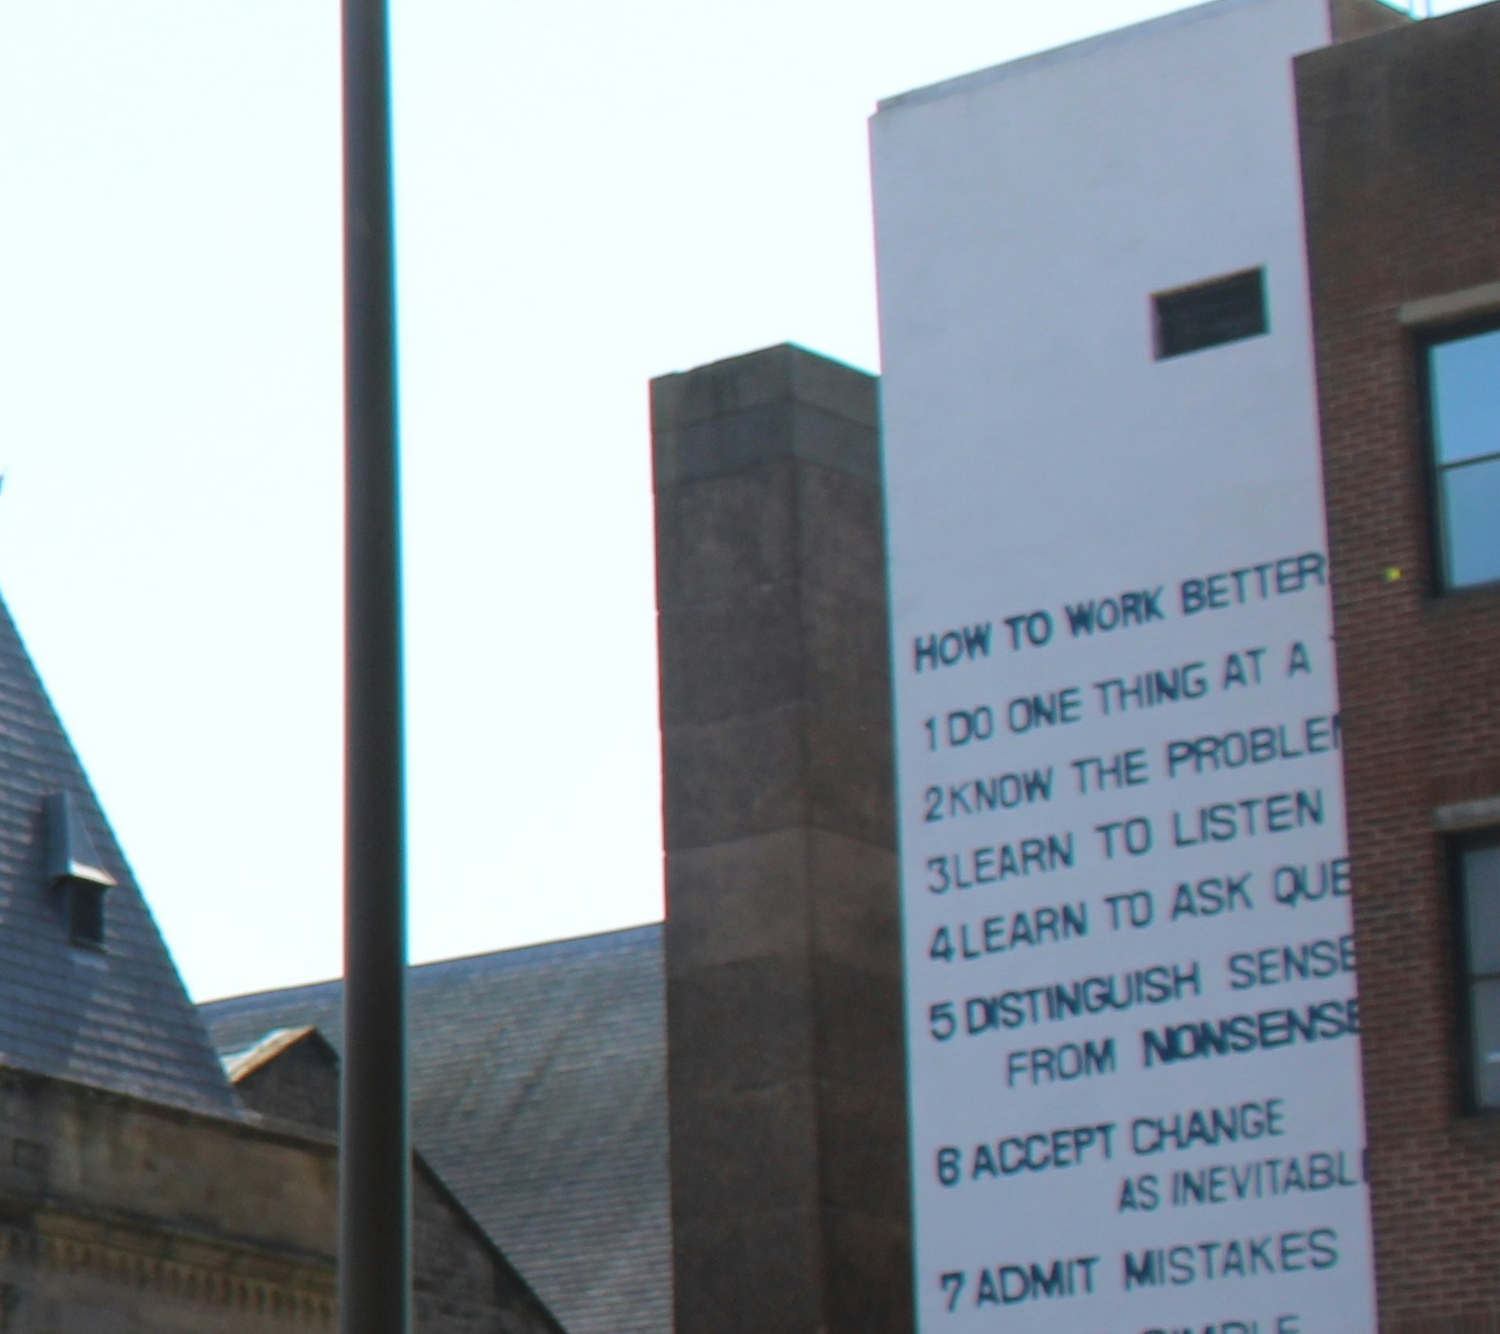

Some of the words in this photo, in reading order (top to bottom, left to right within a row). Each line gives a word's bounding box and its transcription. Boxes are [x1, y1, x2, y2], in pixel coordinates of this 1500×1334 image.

[915, 622, 993, 672] HOW
[1004, 610, 1055, 651] TO
[1065, 586, 1166, 638] WORK
[1181, 552, 1327, 615] BETTER
[925, 716, 938, 751] 1
[948, 705, 995, 747] DO
[1008, 687, 1083, 734] ONE
[1094, 661, 1209, 715] THING
[1223, 647, 1267, 690] AT
[1288, 641, 1312, 678] A
[926, 785, 944, 823] 2
[951, 767, 1055, 817] KNOW
[1071, 748, 1149, 794] THE
[928, 855, 952, 895] 3
[955, 832, 1076, 890] LEARN
[1095, 817, 1154, 859] TO
[1174, 790, 1324, 848] LISTEN
[930, 925, 956, 963] 4
[961, 902, 1090, 960] LEARN
[1104, 890, 1155, 930] TO
[1172, 872, 1254, 922] ASK
[1274, 857, 1350, 908] QUE
[930, 1002, 958, 1043] 5
[966, 961, 1203, 1036] DISTINGUISH
[1008, 1038, 1118, 1089] FROM
[937, 1147, 963, 1188] 6
[972, 1123, 1117, 1181] ACCEPT
[1132, 1099, 1285, 1156] CHANGE
[1119, 1175, 1161, 1213] AS
[1172, 1148, 1368, 1206] INEVITABL
[941, 1271, 968, 1313] 7
[977, 1256, 1100, 1308] ADMIT
[1124, 1228, 1340, 1292] MISTAKES
